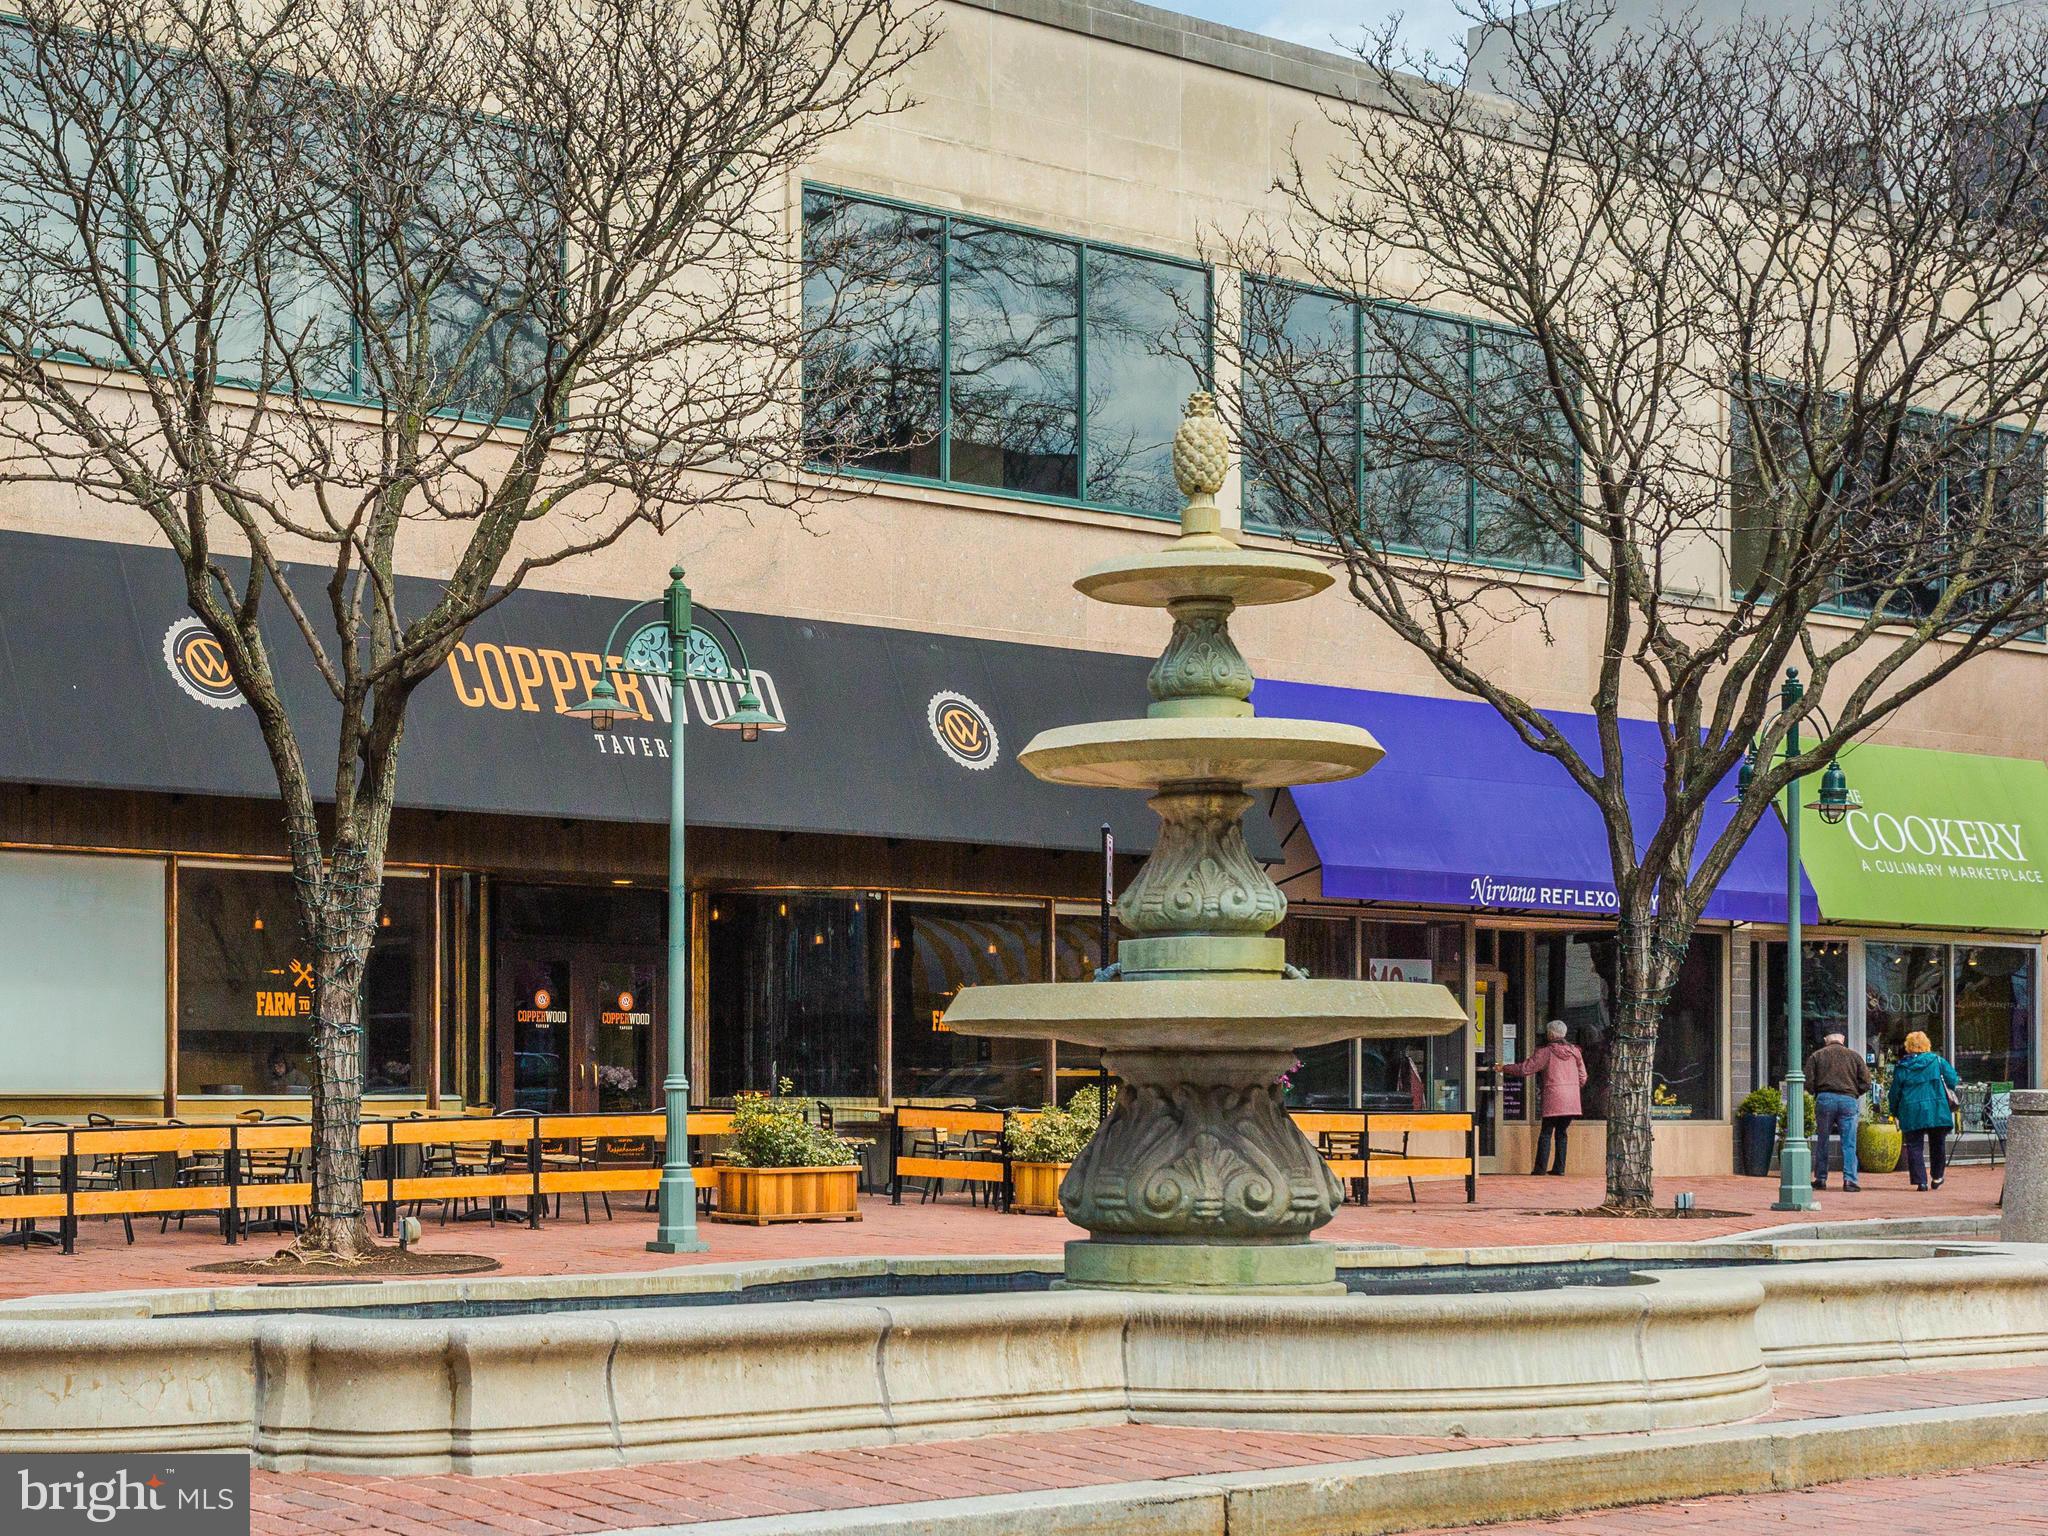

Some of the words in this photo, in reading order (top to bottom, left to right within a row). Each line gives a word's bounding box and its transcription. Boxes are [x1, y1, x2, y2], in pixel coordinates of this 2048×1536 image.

[594, 734, 673, 758] TAVER
[1846, 810, 2029, 862] COOKERY
[1861, 859, 1872, 873] A
[1876, 859, 1943, 878] CULINARY
[1948, 865, 2045, 884] MARKETPLACE
[1470, 875, 1537, 906] Nirvana
[1540, 888, 1660, 910] REFLEXOY
[256, 991, 296, 1017] FARM
[298, 999, 311, 1011] TO
[517, 1010, 567, 1023] COPPERWOOD
[602, 1012, 650, 1025] COPPERWOOD
